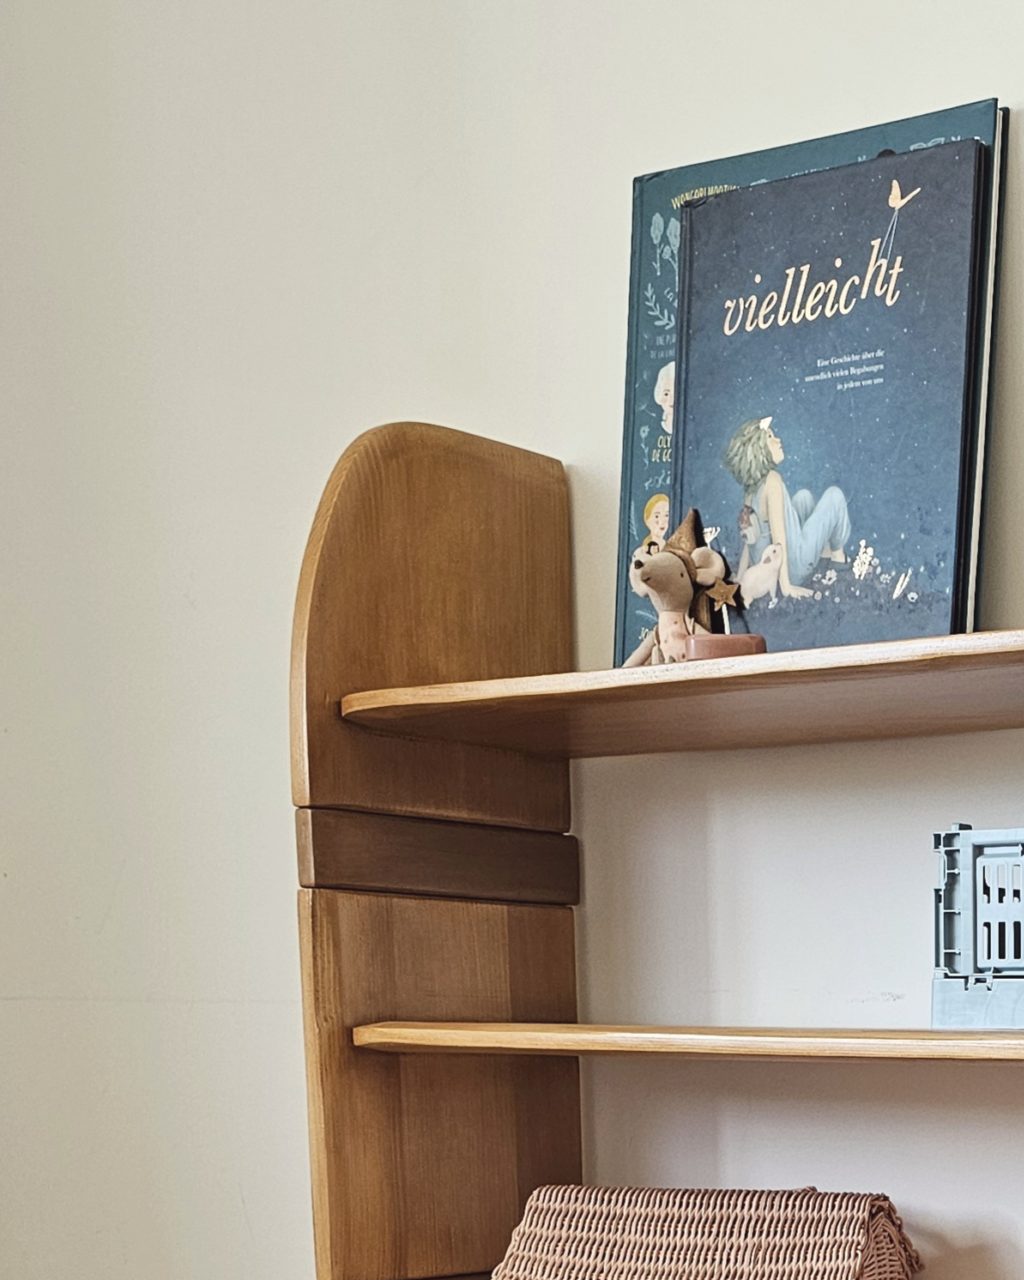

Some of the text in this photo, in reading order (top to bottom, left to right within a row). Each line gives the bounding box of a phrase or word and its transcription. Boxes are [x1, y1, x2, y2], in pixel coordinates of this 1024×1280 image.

[722, 237, 904, 337] vielleicht
[817, 348, 885, 367] Eine Geschichte über die
[805, 364, 884, 382] unendlich vielen Begabungen
